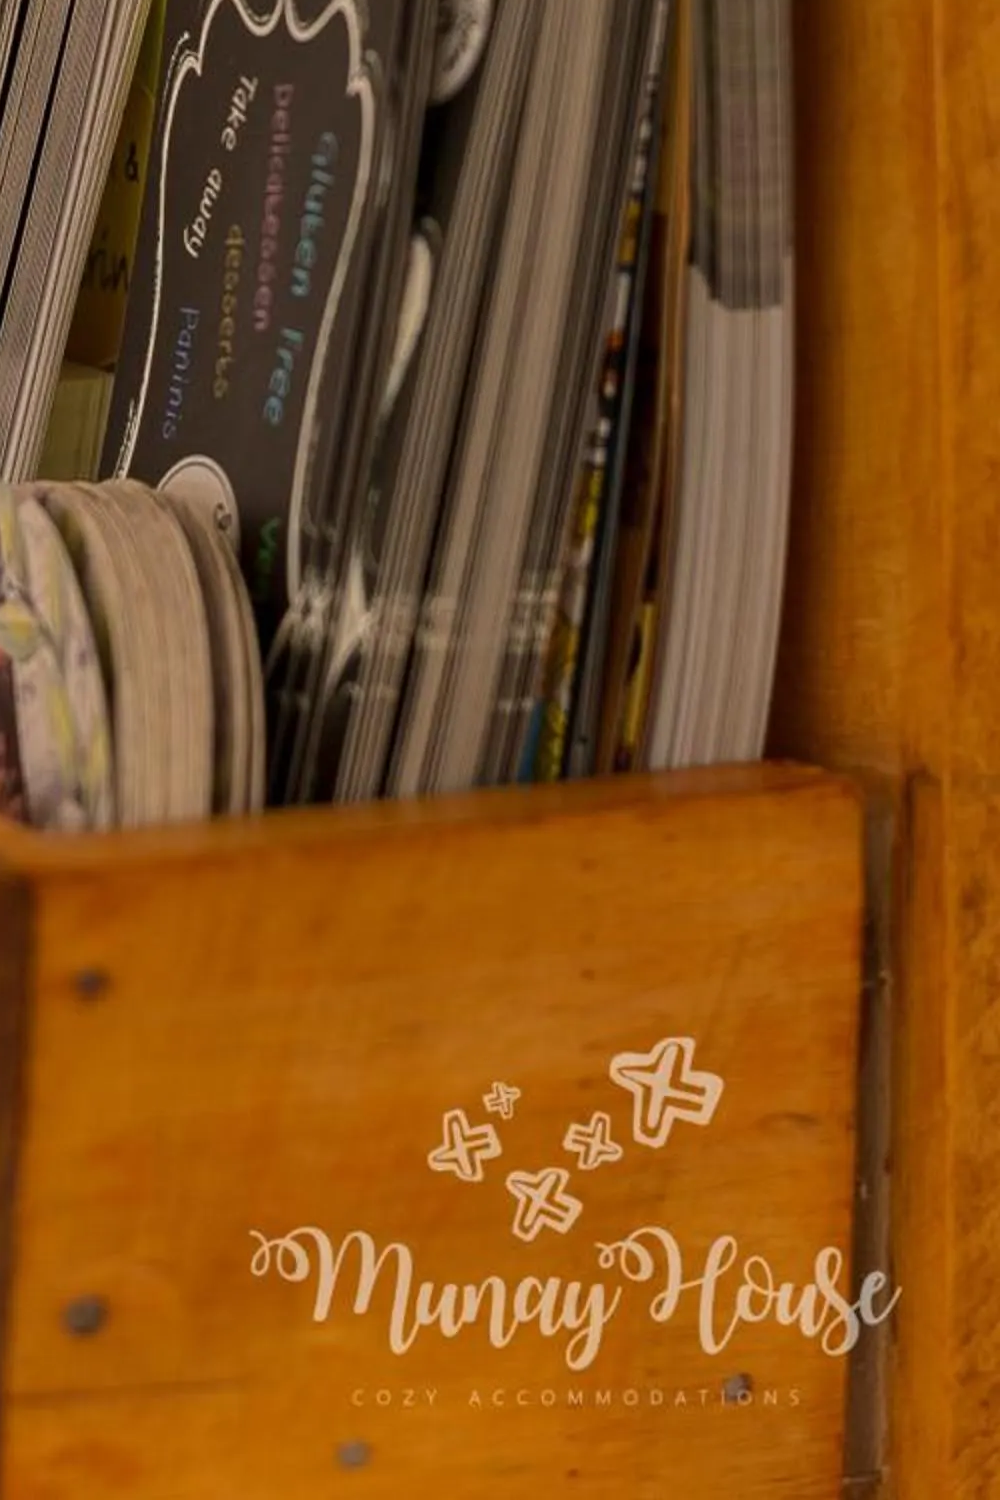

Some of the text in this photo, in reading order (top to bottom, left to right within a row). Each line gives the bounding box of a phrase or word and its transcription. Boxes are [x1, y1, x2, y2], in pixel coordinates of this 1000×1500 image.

[182, 75, 259, 260] Take away
[252, 82, 294, 333] Delicatessen
[289, 130, 337, 298] Gluten
[161, 306, 200, 441] Paninis
[213, 223, 246, 400] desserts
